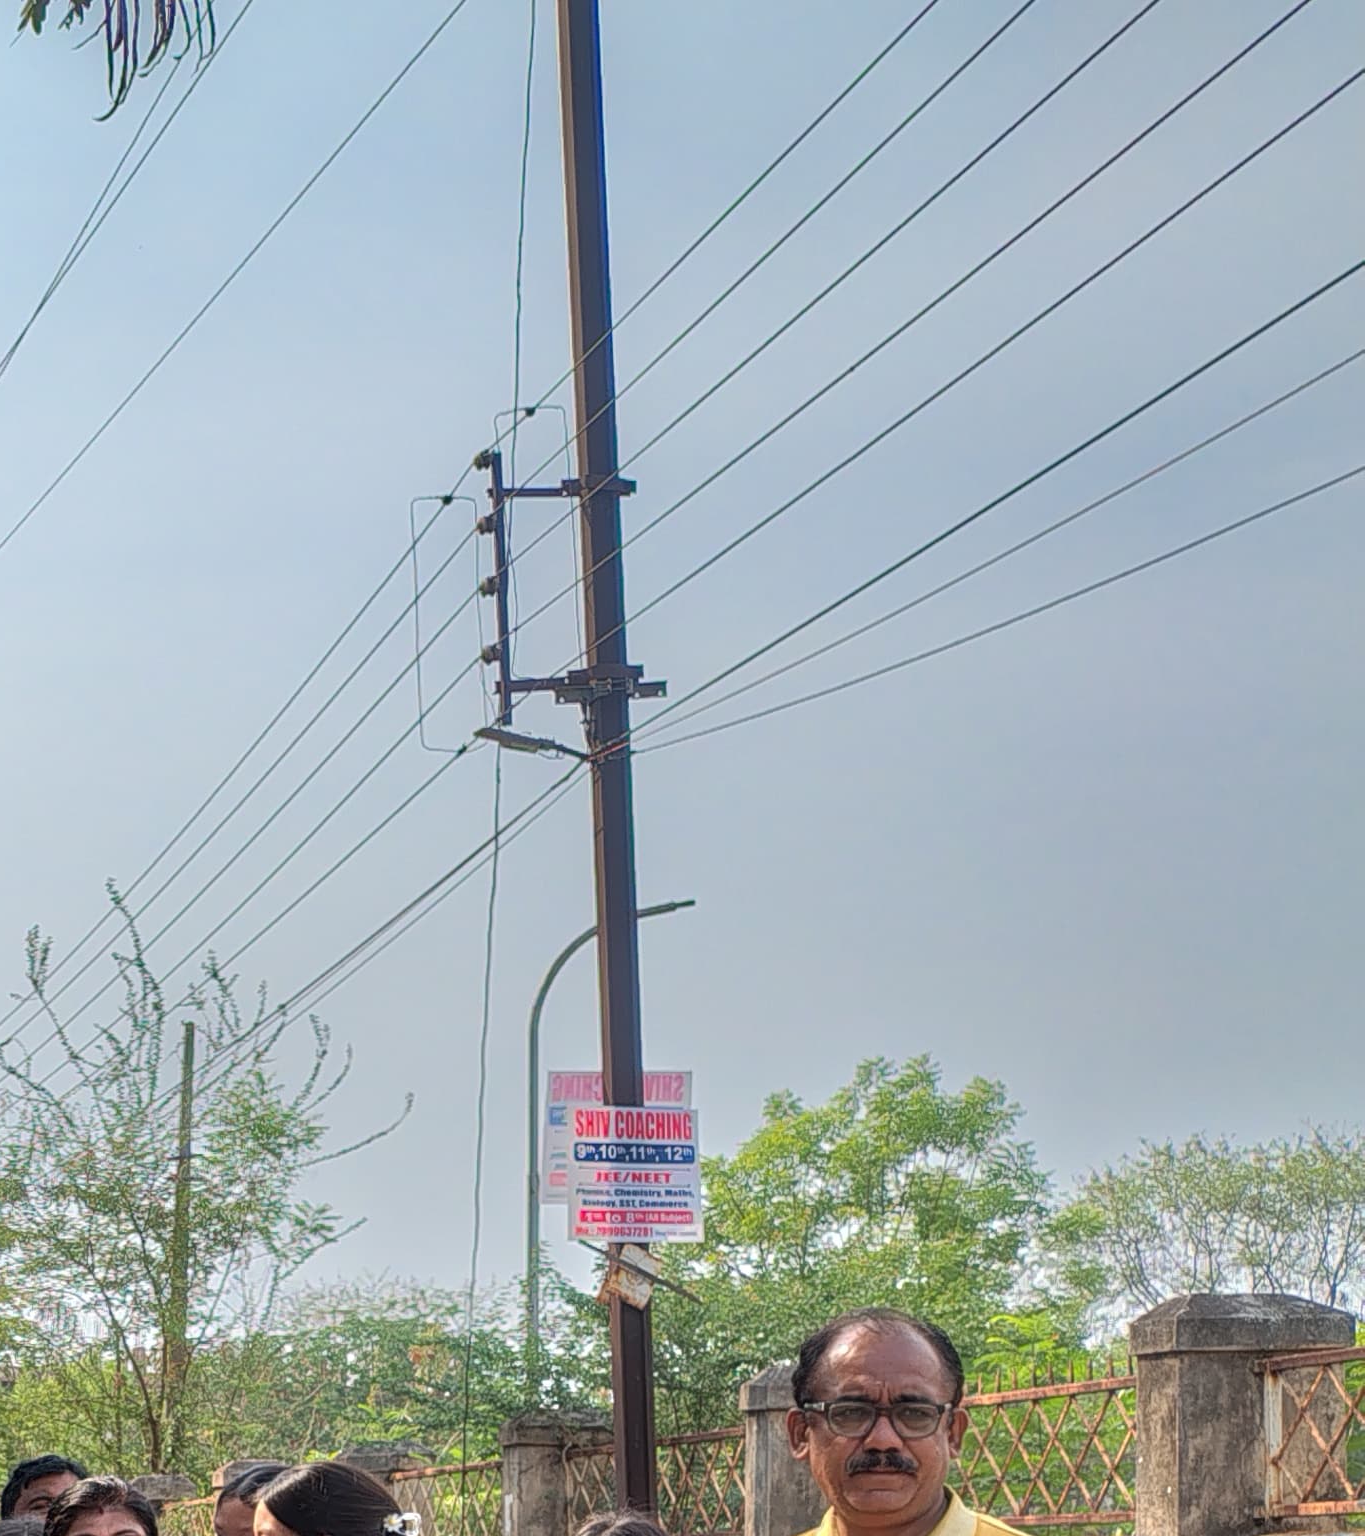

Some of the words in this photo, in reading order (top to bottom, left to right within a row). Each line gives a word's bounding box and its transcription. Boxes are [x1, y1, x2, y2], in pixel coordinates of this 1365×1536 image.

[575, 1110, 610, 1138] SHIV
[614, 1110, 693, 1140] COACHING
[595, 1171, 672, 1185] JEE/NEET
